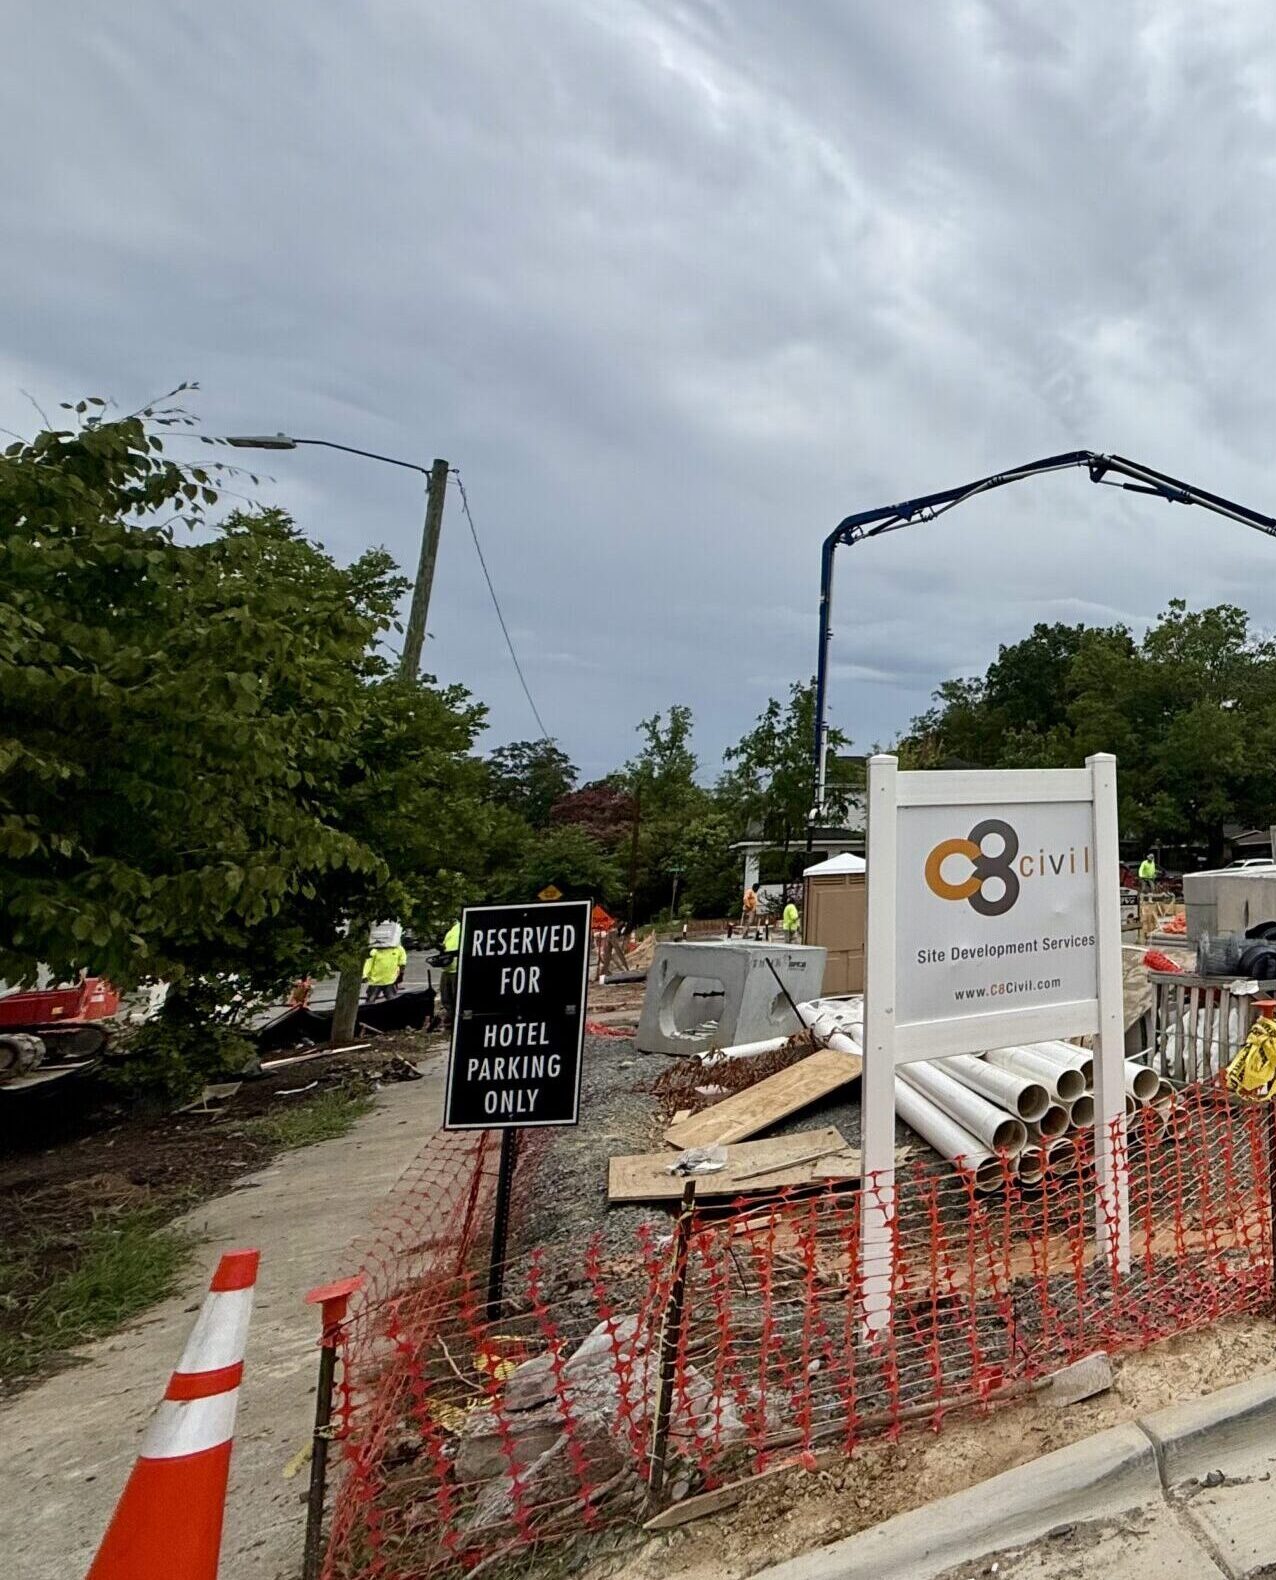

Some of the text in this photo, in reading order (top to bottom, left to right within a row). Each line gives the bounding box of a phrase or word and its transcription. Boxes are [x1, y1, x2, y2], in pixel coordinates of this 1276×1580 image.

[1019, 847, 1089, 878] civil
[472, 925, 576, 957] RESERVED
[917, 934, 1096, 964] Site Development Services
[500, 966, 540, 995] FOR
[954, 977, 1061, 1001] www.C8Civil.com
[483, 1022, 549, 1048] HOTEL
[467, 1054, 561, 1081] PARKING
[484, 1089, 540, 1114] ONLY
